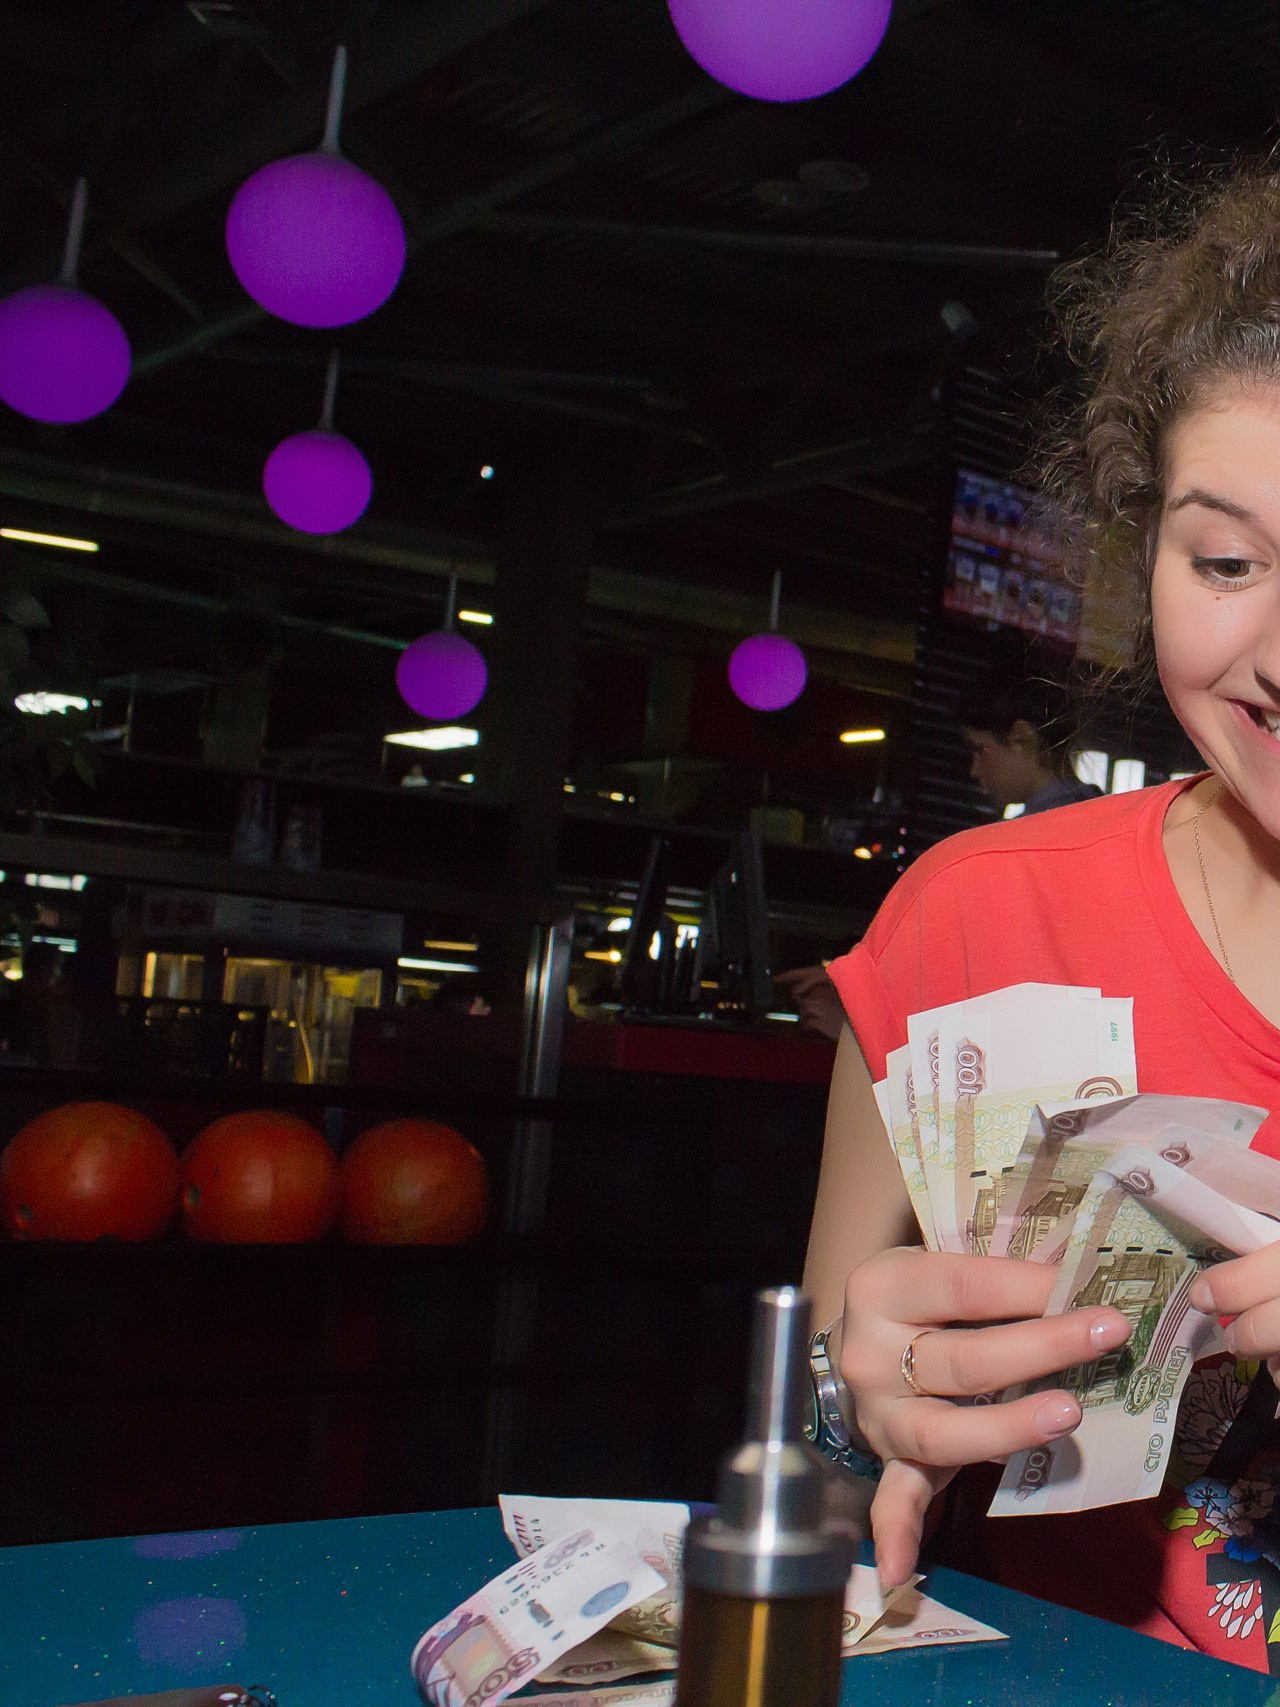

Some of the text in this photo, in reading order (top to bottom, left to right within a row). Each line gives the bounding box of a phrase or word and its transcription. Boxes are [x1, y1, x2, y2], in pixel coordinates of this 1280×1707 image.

[1110, 1021, 1119, 1041] 1997
[957, 1049, 979, 1096] 100
[1143, 1346, 1189, 1472] СТО РУБЛЕЙ
[1021, 1452, 1046, 1490] 100
